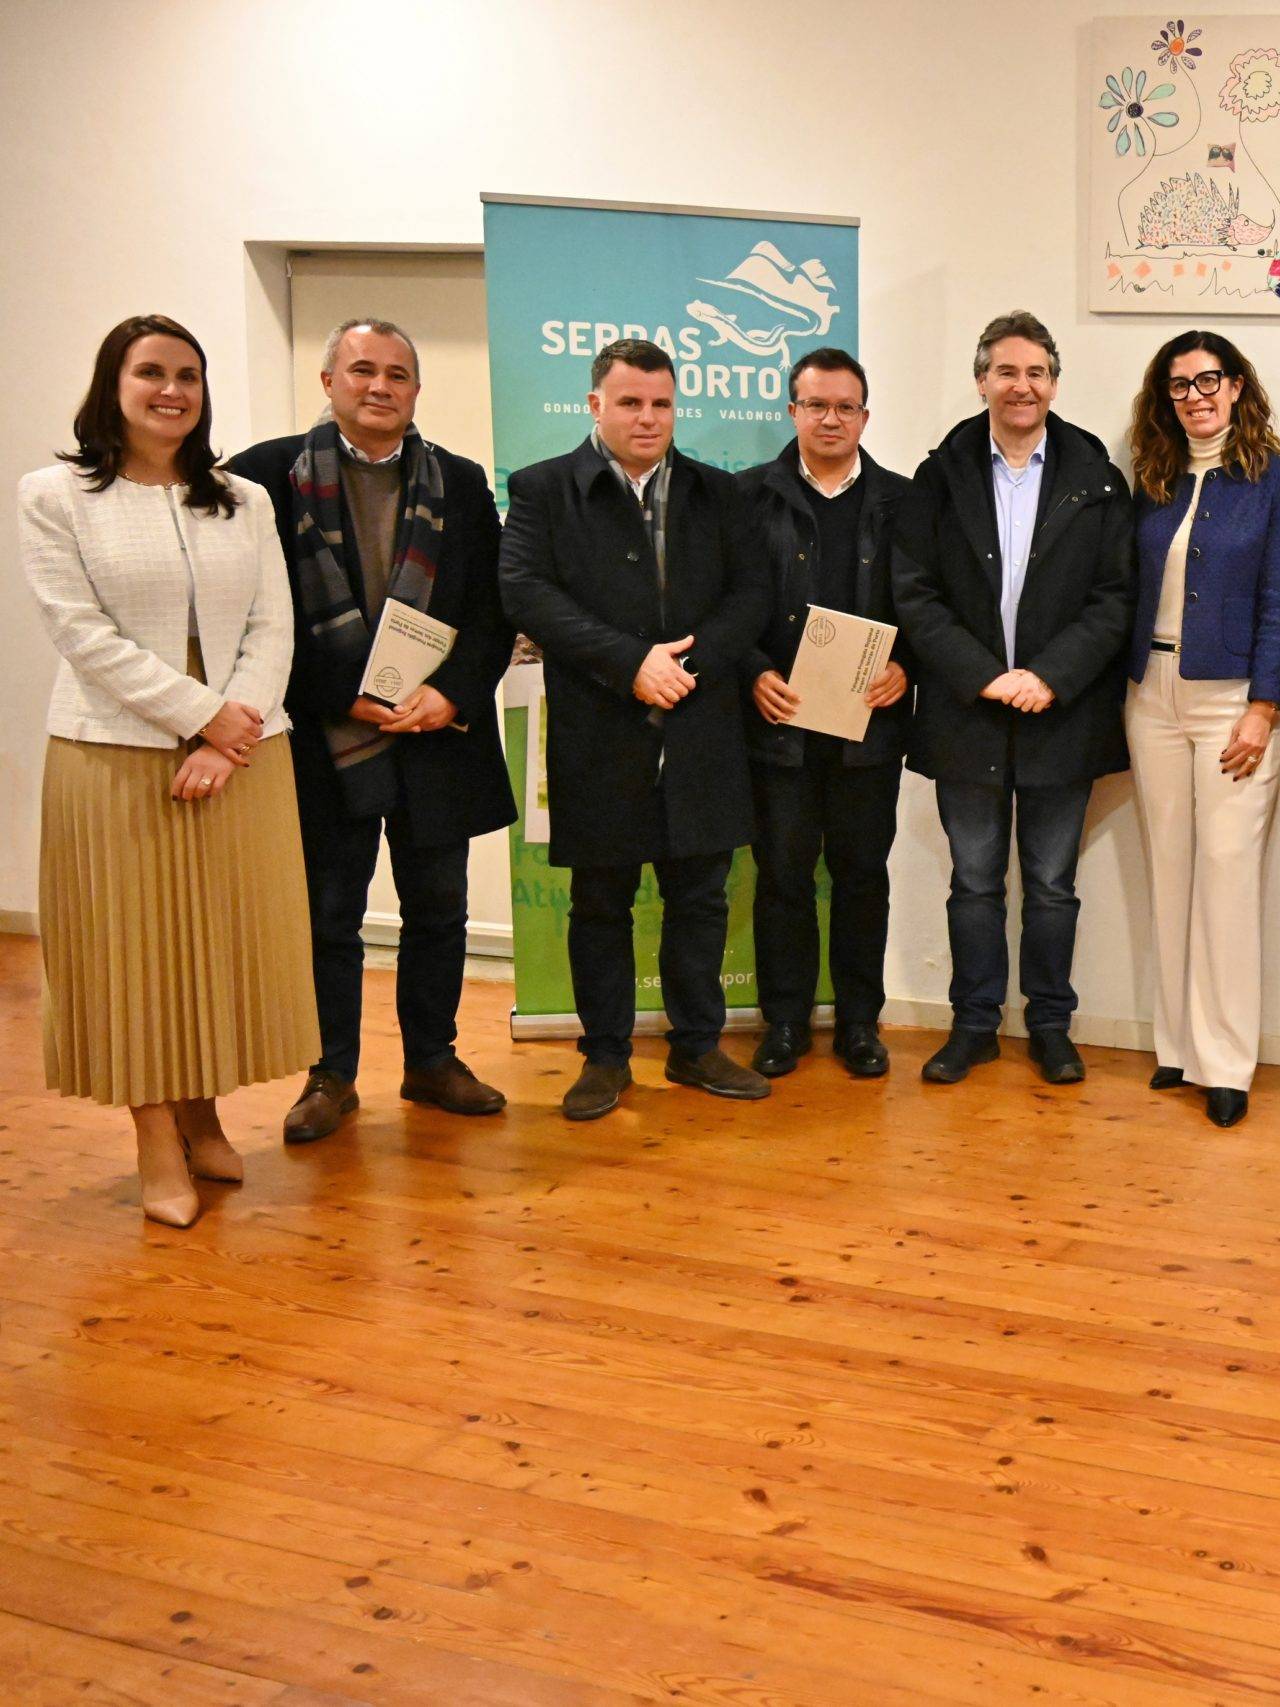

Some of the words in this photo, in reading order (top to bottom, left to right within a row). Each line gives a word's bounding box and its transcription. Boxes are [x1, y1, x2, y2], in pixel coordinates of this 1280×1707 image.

[678, 363, 782, 400] ORTO
[543, 403, 591, 414] GONDO
[676, 408, 703, 418] DES
[720, 410, 782, 422] VALONGO
